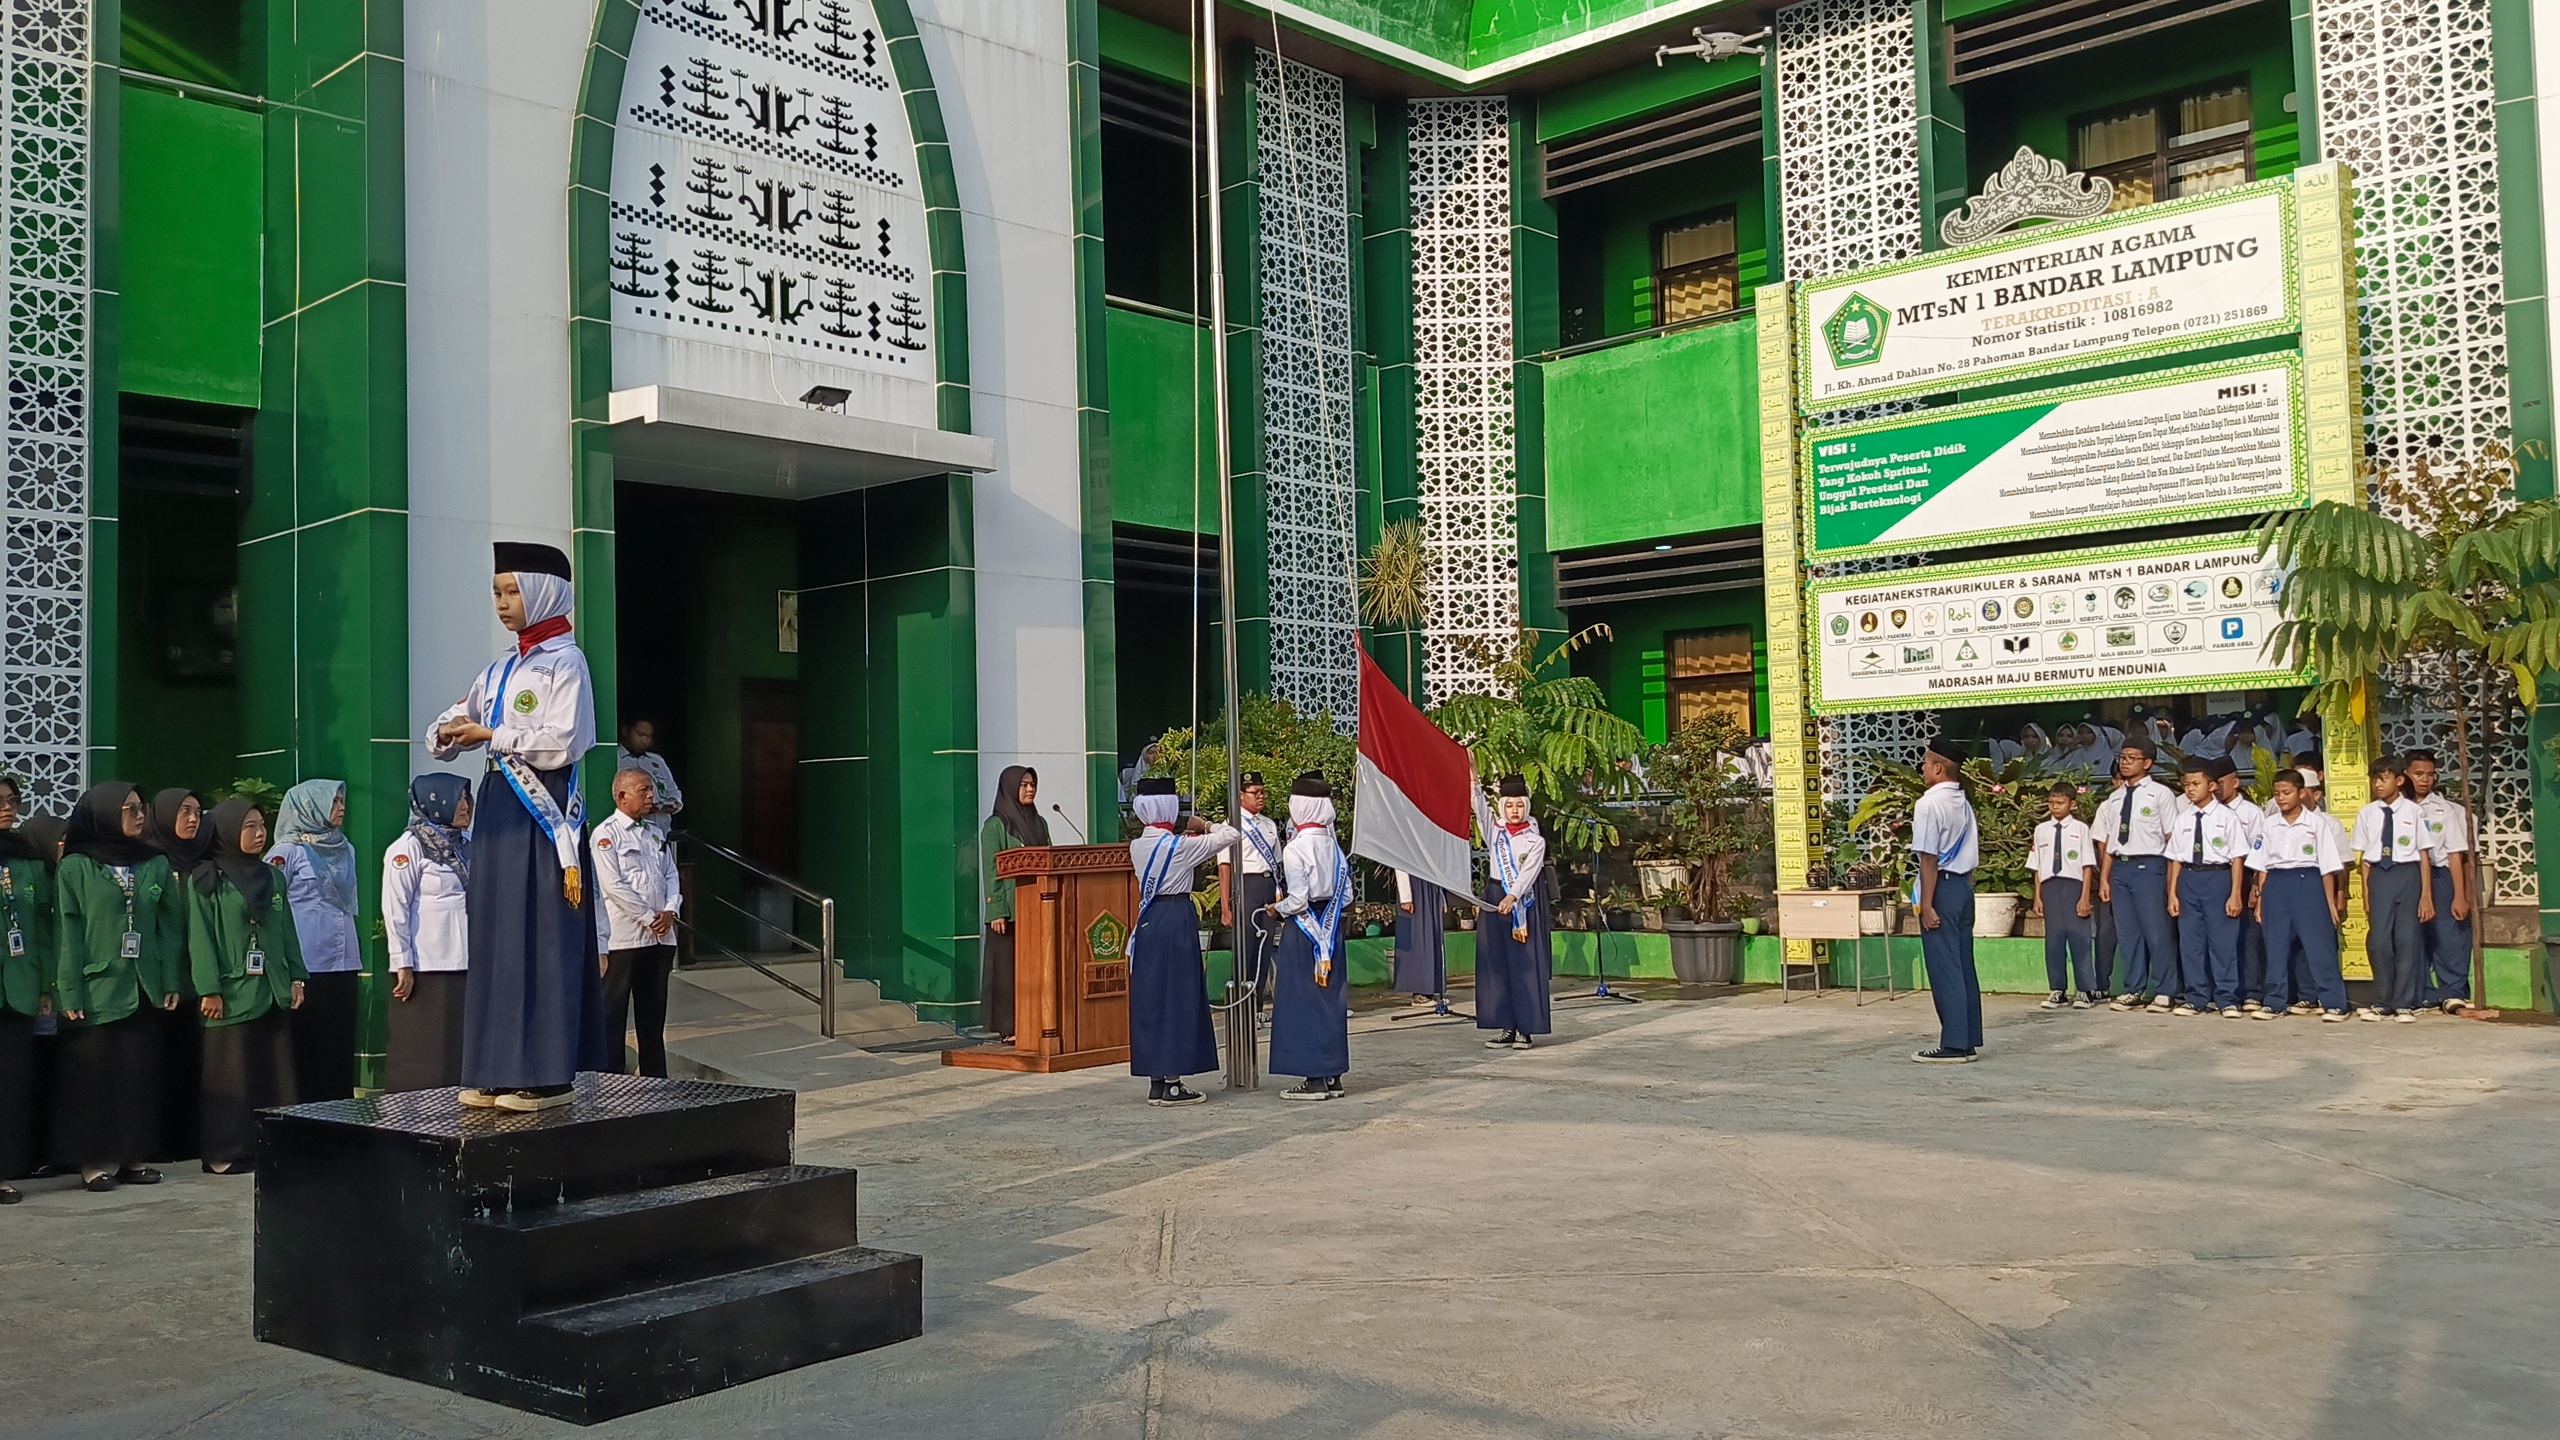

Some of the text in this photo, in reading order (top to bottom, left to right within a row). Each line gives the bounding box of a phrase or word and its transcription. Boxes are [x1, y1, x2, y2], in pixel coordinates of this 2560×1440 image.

[1945, 225, 2196, 289] KEMENTERIAN AGAMA
[1897, 237, 2258, 325] MTsN 1 BANDAR LAMPUNG
[1981, 291, 2132, 331] TERAKREDITASI
[2147, 286, 2159, 299] A
[1971, 331, 2022, 347] Nomor
[2025, 317, 2086, 337] Statistik
[2103, 300, 2173, 323] 10816982
[1837, 381, 1855, 390] Kh.
[1857, 372, 1893, 386] Ahmad
[1896, 367, 1934, 379] Dahlan
[1937, 363, 1955, 372] No.
[1957, 359, 1970, 369] 28
[1972, 351, 2025, 366] Pahoman
[2028, 343, 2070, 356] Bandar
[2073, 332, 2129, 348] Lampung
[2132, 323, 2180, 337] Telepon
[2183, 314, 2221, 330] (0721)
[2224, 305, 2268, 321] 251869
[2217, 384, 2256, 399] MISI
[1817, 443, 1966, 473] Terwujudnya Peserta Didik
[1818, 443, 1848, 457] VISI
[1818, 463, 1931, 487] Yang Kokoh Spritual,
[1818, 479, 1929, 501] Unggul Prestasi Dan
[1819, 492, 1922, 515] Bijak Berteknologi
[1846, 553, 2259, 605] KEGIATANEKSTRAKURIKULER & SARANA MTsN 1 BANDAR LAMPUNG
[2226, 622, 2239, 636] P
[1928, 663, 2167, 688] MADRASAH MAJU BERMUTU MENDUNIA
